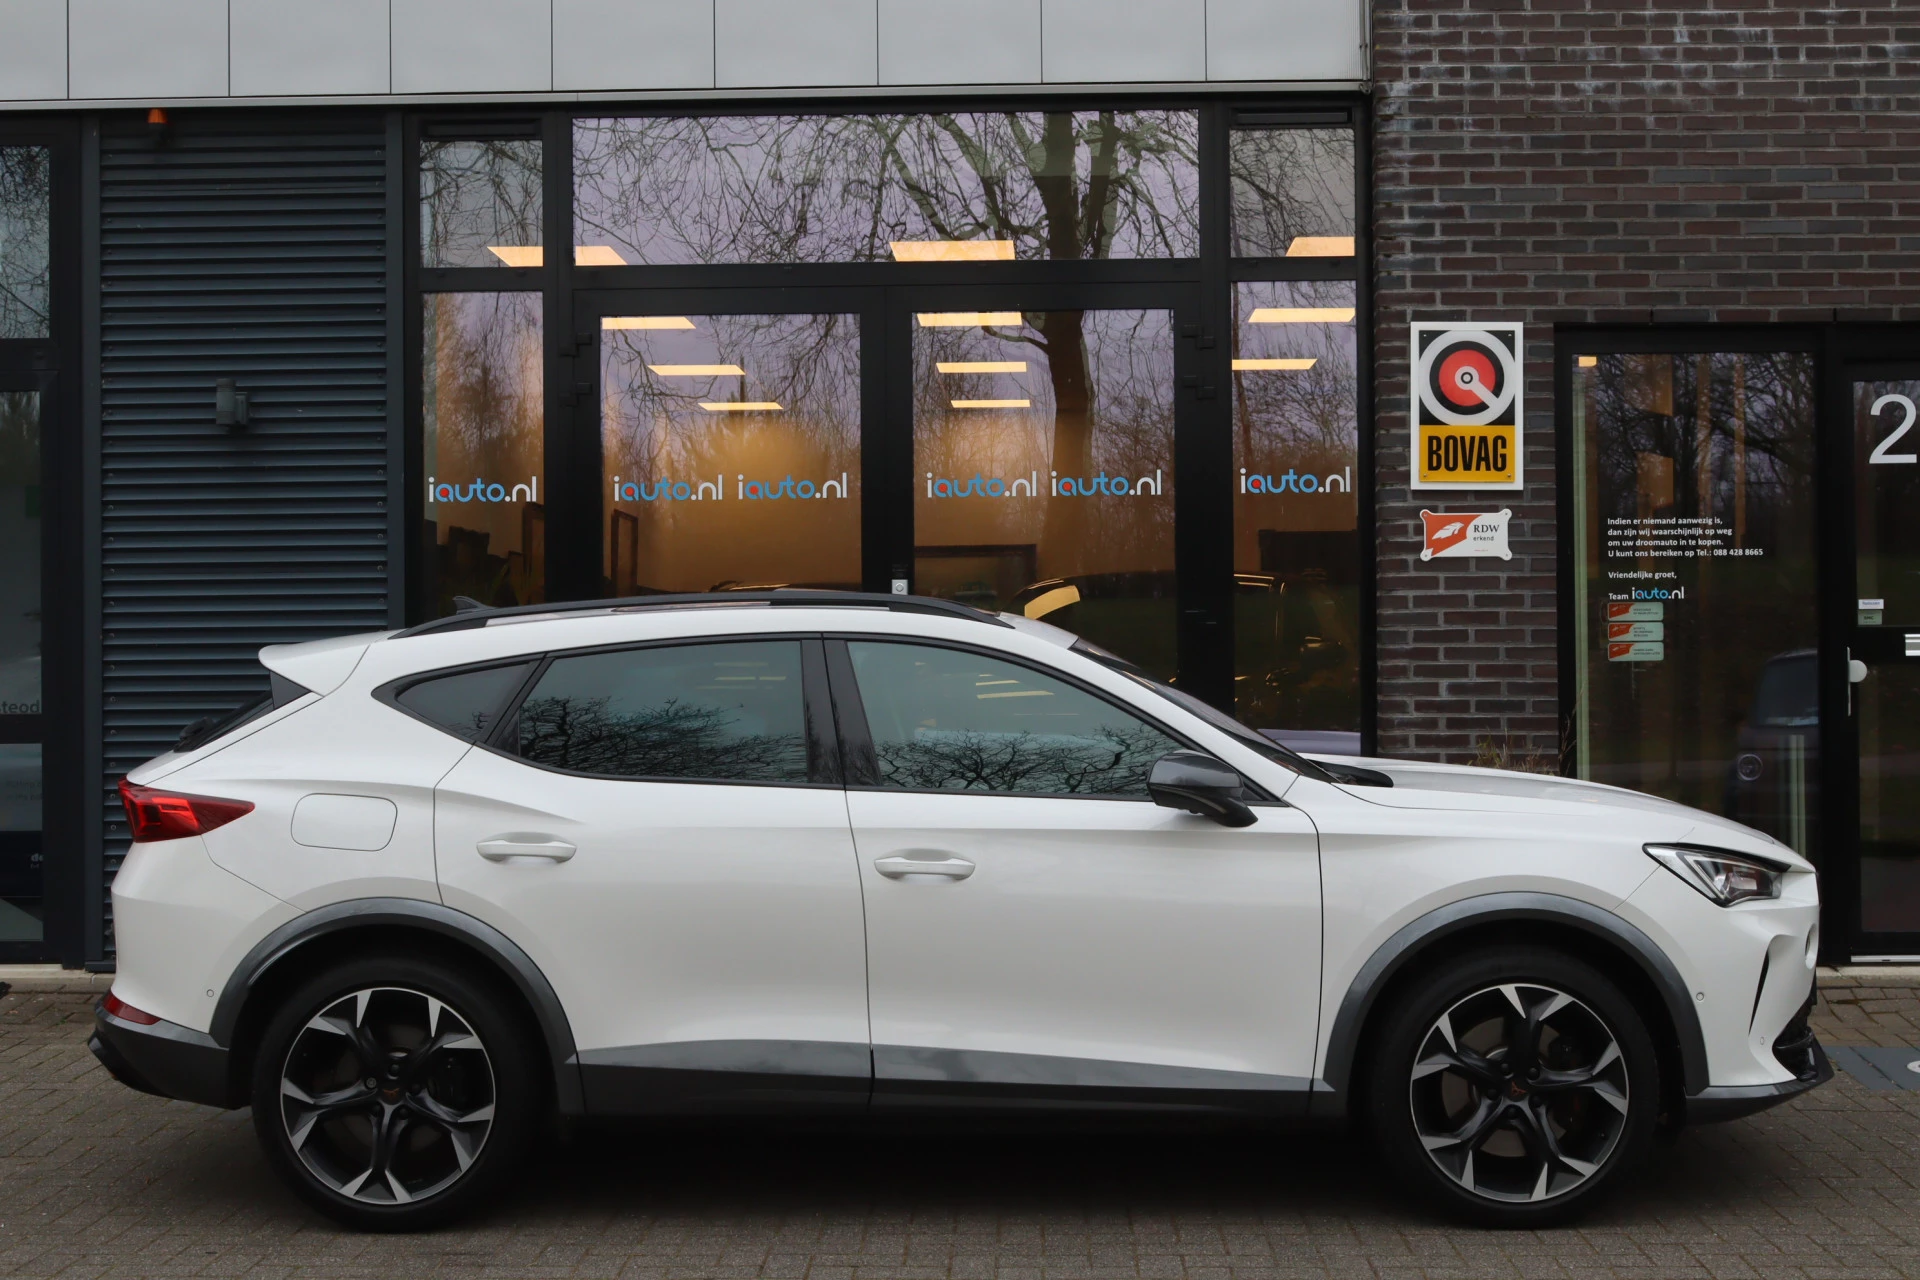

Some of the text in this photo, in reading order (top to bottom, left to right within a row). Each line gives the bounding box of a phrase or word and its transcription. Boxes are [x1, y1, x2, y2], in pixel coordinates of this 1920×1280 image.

[1869, 394, 1918, 464] 2
[1427, 435, 1507, 472] BOVAG
[613, 472, 847, 502] iauto.nl iauto.nl
[926, 469, 1162, 498] iauto.nl iauto.nl
[1240, 466, 1351, 494] iauto.nl
[428, 476, 537, 502] iauto.nl
[1607, 517, 1632, 525] Indien
[1643, 517, 1676, 525] niemand
[1677, 516, 1713, 526] aanwezig
[1714, 516, 1723, 525] is,
[1473, 524, 1500, 533] RDW
[1607, 528, 1622, 536] dan
[1623, 528, 1637, 537] zijn
[1638, 527, 1651, 537] wij
[1652, 527, 1704, 537] waarschijnlijk
[1716, 528, 1733, 536] weg
[1635, 539, 1678, 547] droomauto
[1679, 538, 1687, 546] in
[1698, 538, 1724, 547] kopen.
[1615, 549, 1633, 557] kunt
[1650, 549, 1683, 557] bereiken
[1684, 550, 1695, 558] op
[1696, 549, 1712, 557] Tel.:
[1713, 548, 1728, 556] 088
[1729, 548, 1744, 556] 428
[1745, 548, 1764, 556] 8665
[1608, 571, 1677, 580] Vriendelijke groet,
[1608, 586, 1685, 600] Team iauto.nl
[0, 699, 40, 713] teod
